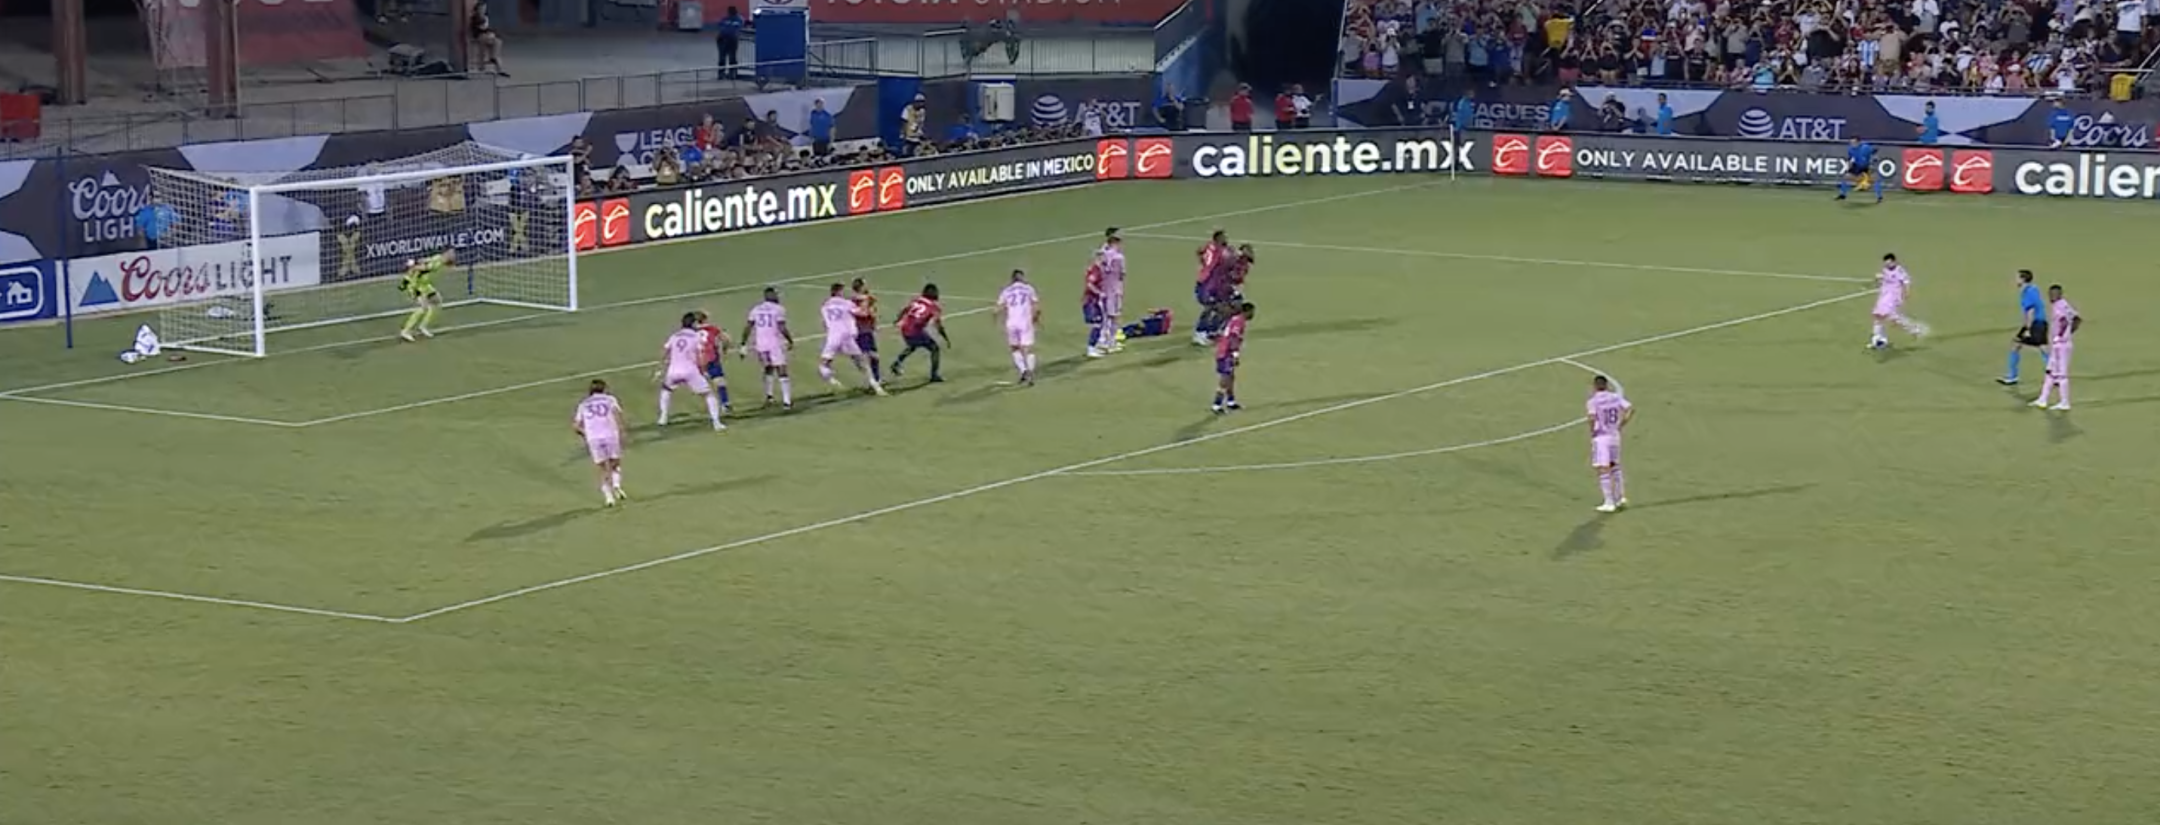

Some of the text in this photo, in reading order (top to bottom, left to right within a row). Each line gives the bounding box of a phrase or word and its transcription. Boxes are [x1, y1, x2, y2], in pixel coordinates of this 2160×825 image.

[1780, 117, 1847, 140] AT&T
[1192, 135, 1475, 176] caliente.mx
[1576, 149, 1896, 177] ONLY AVAILABLE IN MEXO
[906, 154, 1095, 195] ONLY AVAILABLE IN MEXICO
[645, 184, 838, 239] caliente.mx
[83, 216, 134, 242] LIGH
[120, 255, 211, 302] Coors
[1006, 291, 1028, 307] 27
[757, 313, 773, 328] 31
[586, 402, 609, 420] 30
[1603, 407, 1618, 425] 18
